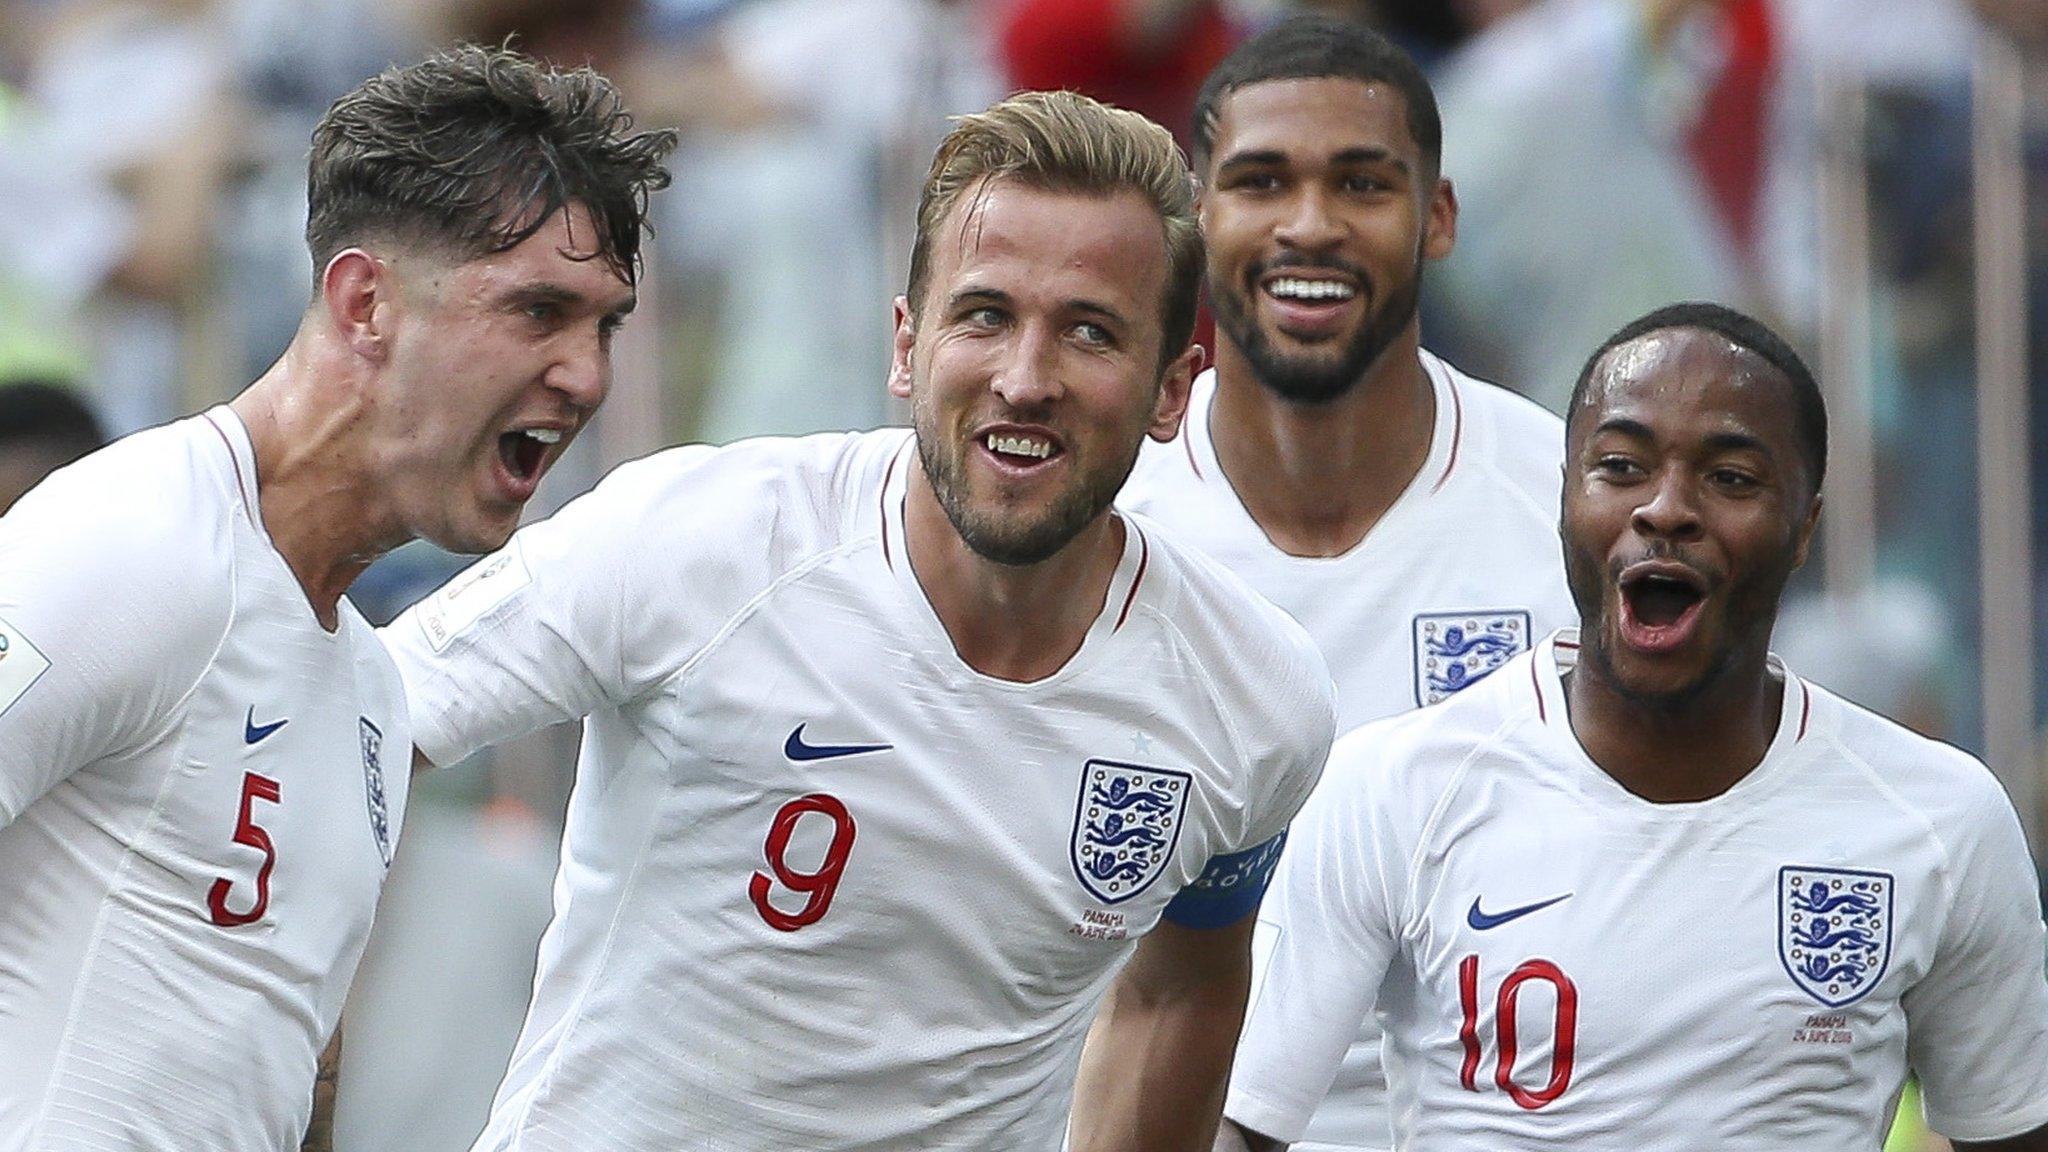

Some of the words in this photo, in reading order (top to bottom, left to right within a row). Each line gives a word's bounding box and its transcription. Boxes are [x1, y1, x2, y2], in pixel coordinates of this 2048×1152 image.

[207, 771, 281, 927] 5
[748, 793, 856, 932] 9
[1459, 954, 1577, 1110] 10
